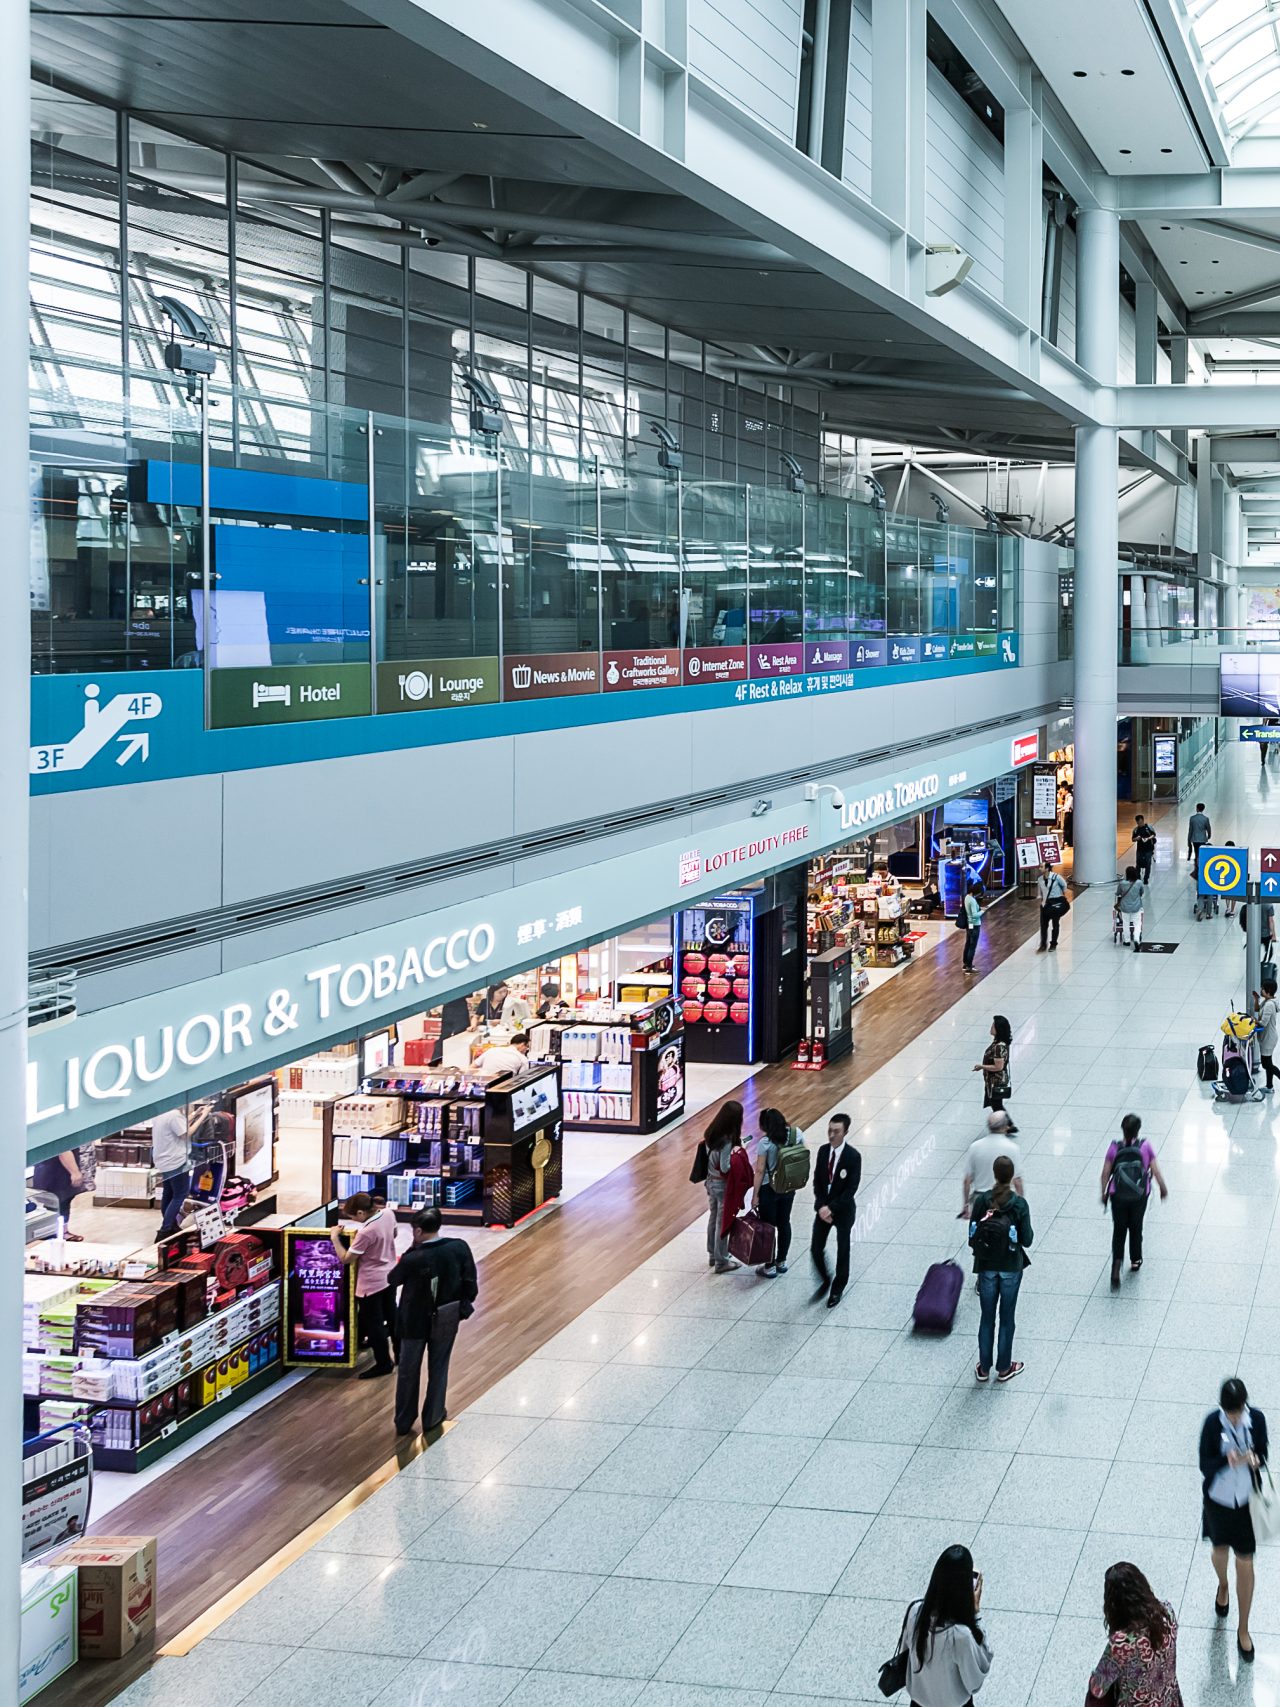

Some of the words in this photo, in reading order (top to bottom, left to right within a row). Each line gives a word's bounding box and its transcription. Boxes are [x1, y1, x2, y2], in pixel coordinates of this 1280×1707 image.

[633, 655, 667, 666] Traditional
[702, 660, 728, 672] Internet
[728, 659, 745, 669] Zone
[772, 656, 785, 666] Rest
[785, 655, 797, 665] Area
[533, 670, 560, 685] News
[561, 672, 567, 683] &
[567, 667, 596, 682] Movie
[622, 667, 657, 678] Craftworks
[657, 666, 679, 677] Gallery
[300, 683, 340, 703] Hotel
[440, 676, 484, 694] Lounge
[735, 683, 747, 701] 4F
[749, 683, 769, 700] Rest
[771, 681, 778, 697] &
[779, 679, 802, 696] Relax
[127, 696, 152, 716] 4F
[37, 748, 64, 770] 3F
[841, 793, 884, 830] LIQUOR
[885, 789, 893, 812] &
[894, 774, 939, 808] TOBACCO
[705, 846, 746, 873] LOTTE
[748, 834, 780, 858] DUTY
[781, 825, 809, 846] FREE
[26, 1002, 253, 1125] LIQUOR
[263, 988, 300, 1036] &
[306, 922, 495, 1018] TOBACCO
